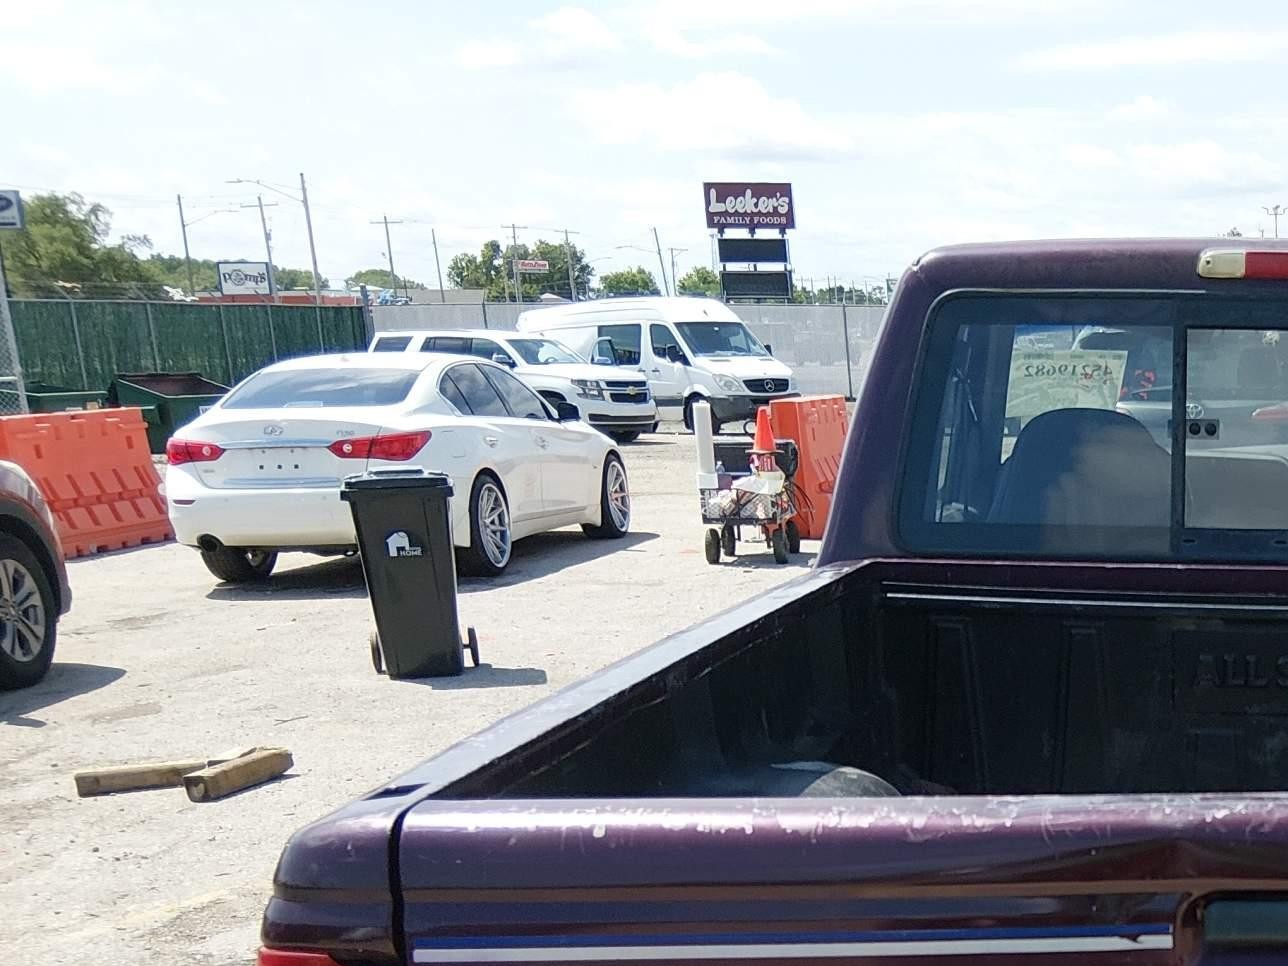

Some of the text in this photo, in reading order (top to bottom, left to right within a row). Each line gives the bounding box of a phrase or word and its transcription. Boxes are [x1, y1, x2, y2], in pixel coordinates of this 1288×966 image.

[708, 187, 789, 214] Leeker's
[713, 216, 787, 224] FAMILY FOODS
